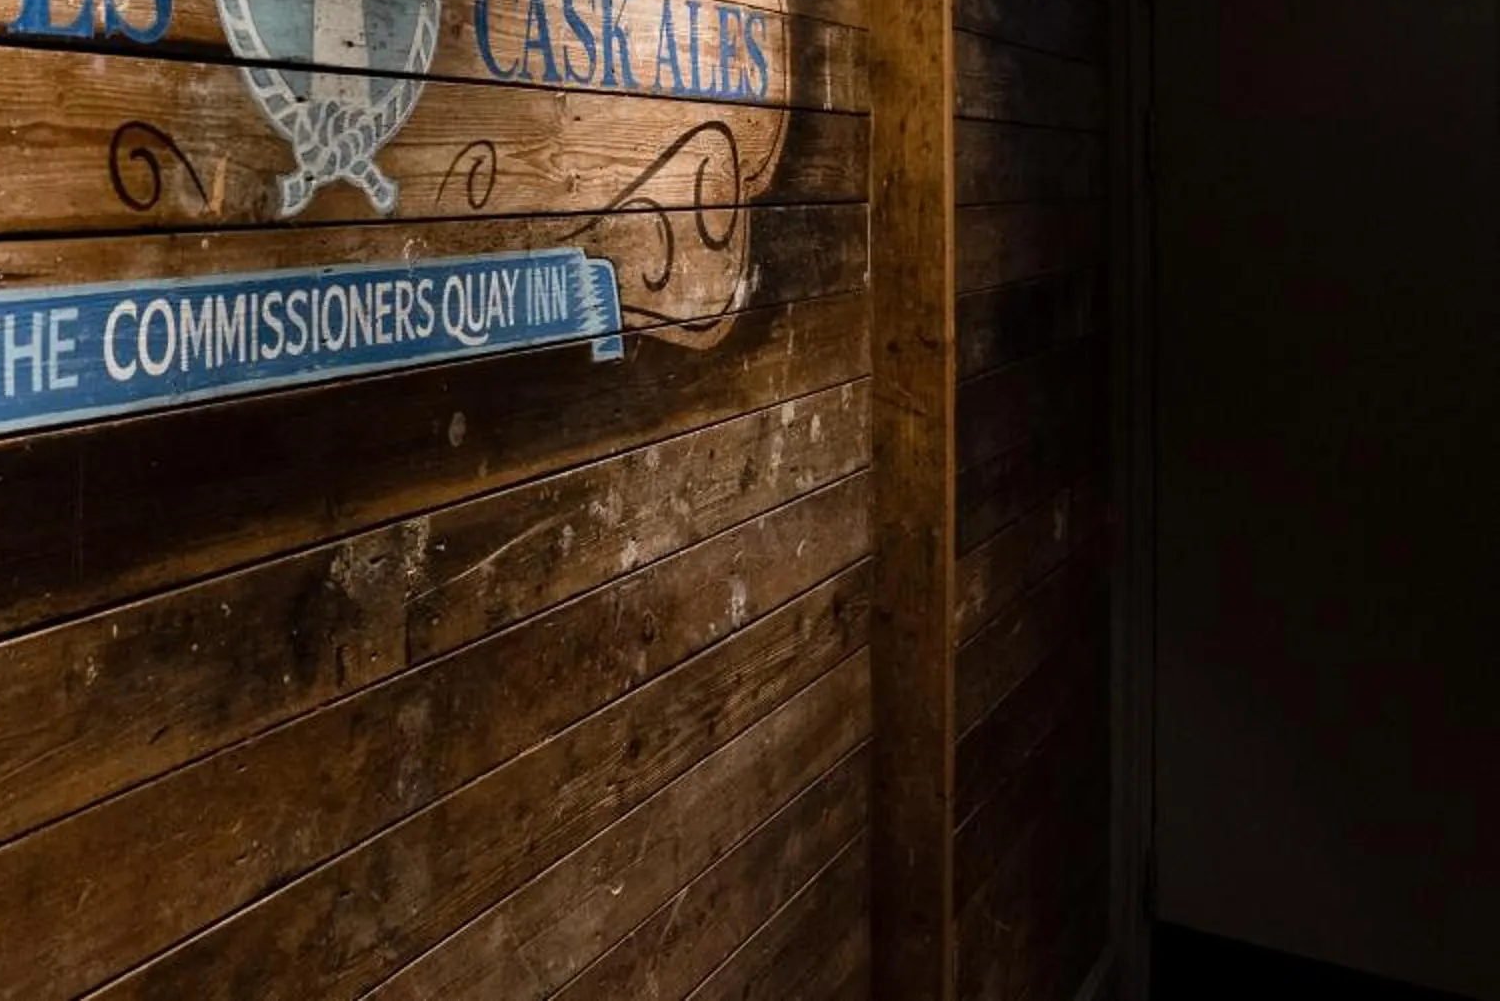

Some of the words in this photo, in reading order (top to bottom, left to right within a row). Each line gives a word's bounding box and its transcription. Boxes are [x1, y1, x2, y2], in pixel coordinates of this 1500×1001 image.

[103, 278, 435, 381] COMMISSIONERS
[442, 268, 520, 346] QUAY
[526, 264, 568, 326] INN
